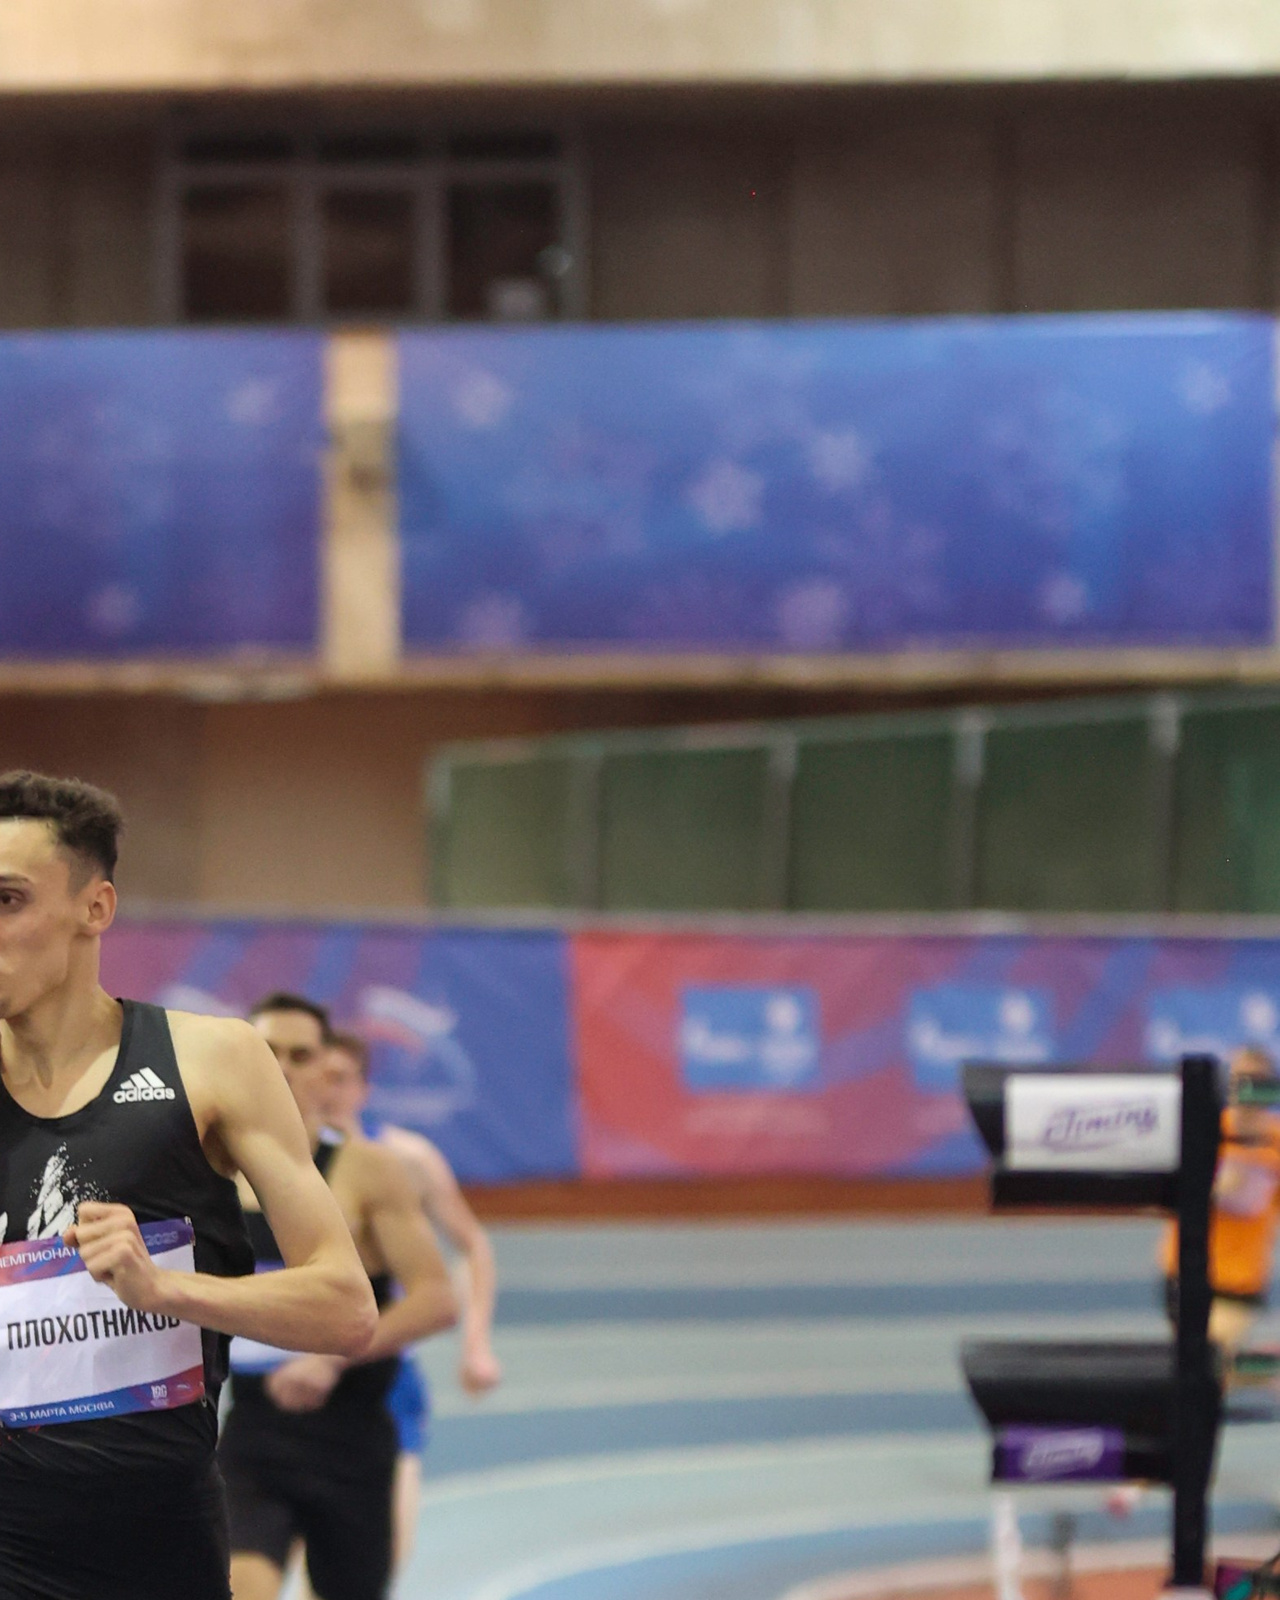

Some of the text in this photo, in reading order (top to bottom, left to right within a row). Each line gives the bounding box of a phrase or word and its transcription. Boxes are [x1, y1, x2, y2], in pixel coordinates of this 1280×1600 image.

[113, 1086, 176, 1104] adidas
[30, 1407, 67, 1420] МАРТА
[68, 1400, 115, 1415] МОСКВА
